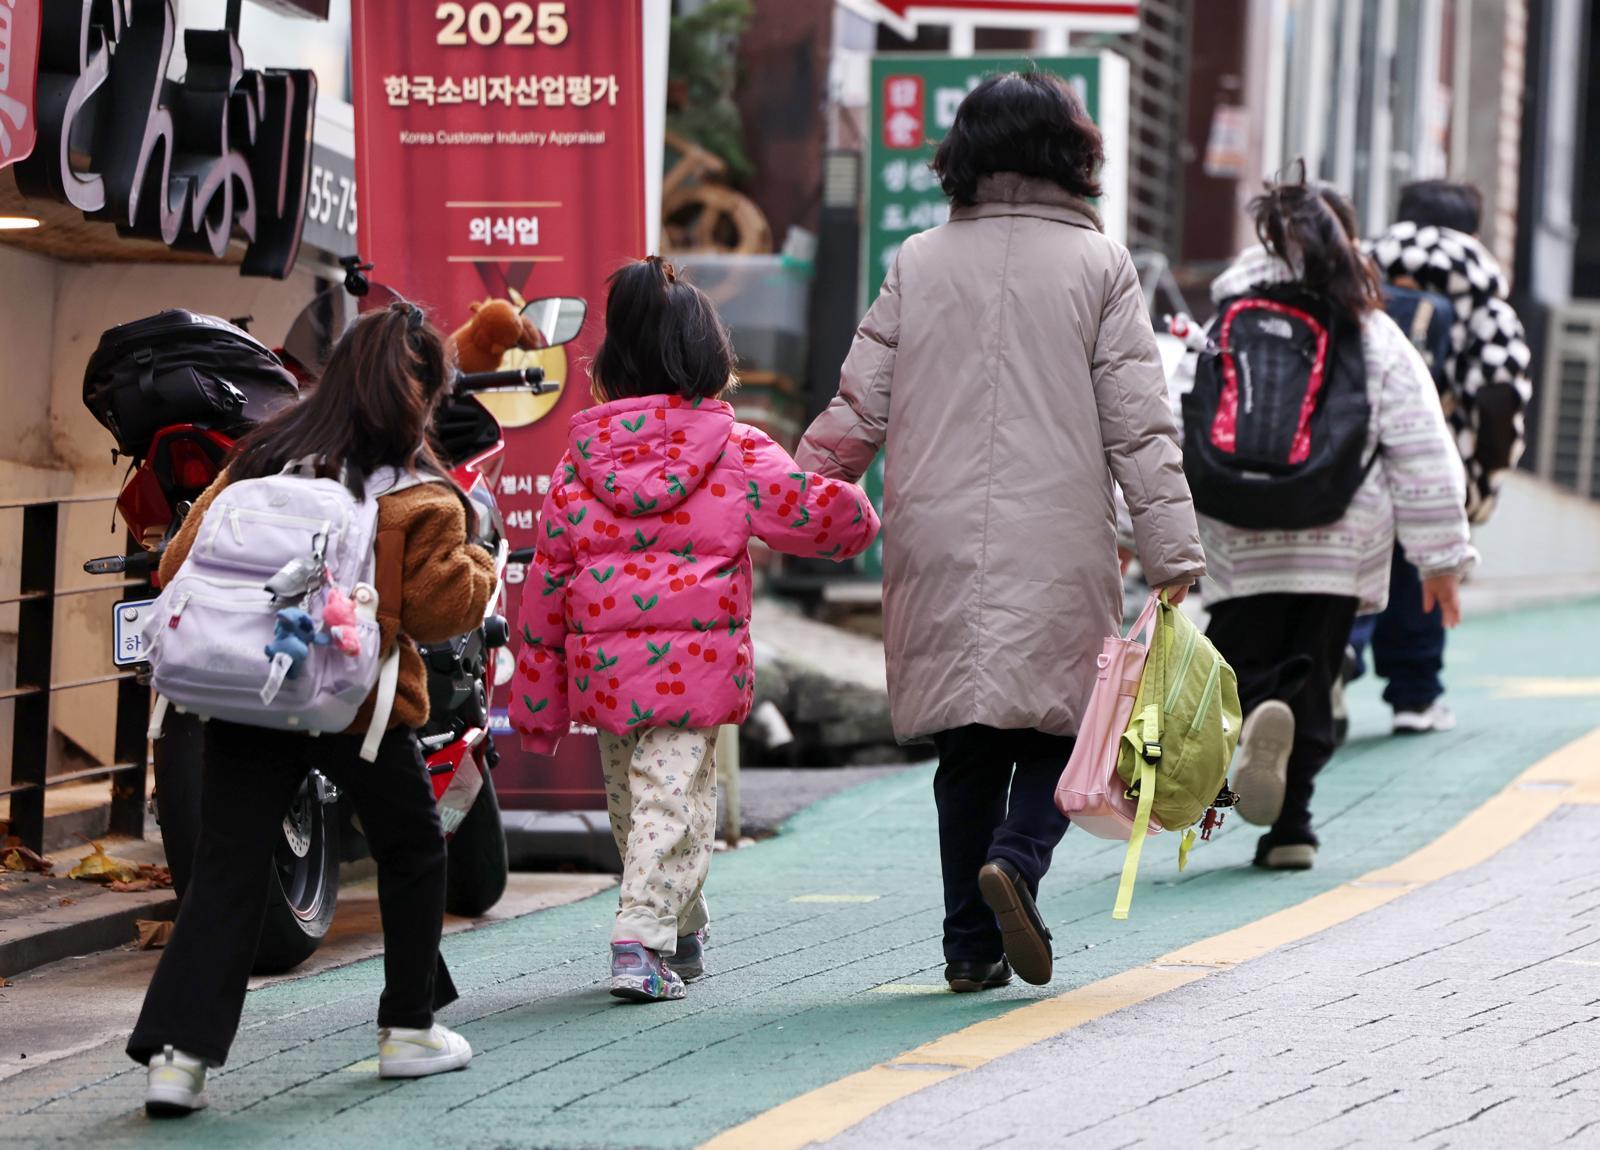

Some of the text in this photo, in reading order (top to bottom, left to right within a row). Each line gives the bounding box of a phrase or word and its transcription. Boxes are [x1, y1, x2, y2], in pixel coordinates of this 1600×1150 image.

[435, 1, 569, 46] 2025
[384, 74, 619, 107] 한국소비자산업평가
[400, 130, 606, 147] Korea Customer Industry Appraisal
[468, 216, 539, 246] 외식업
[496, 474, 532, 495] 별시
